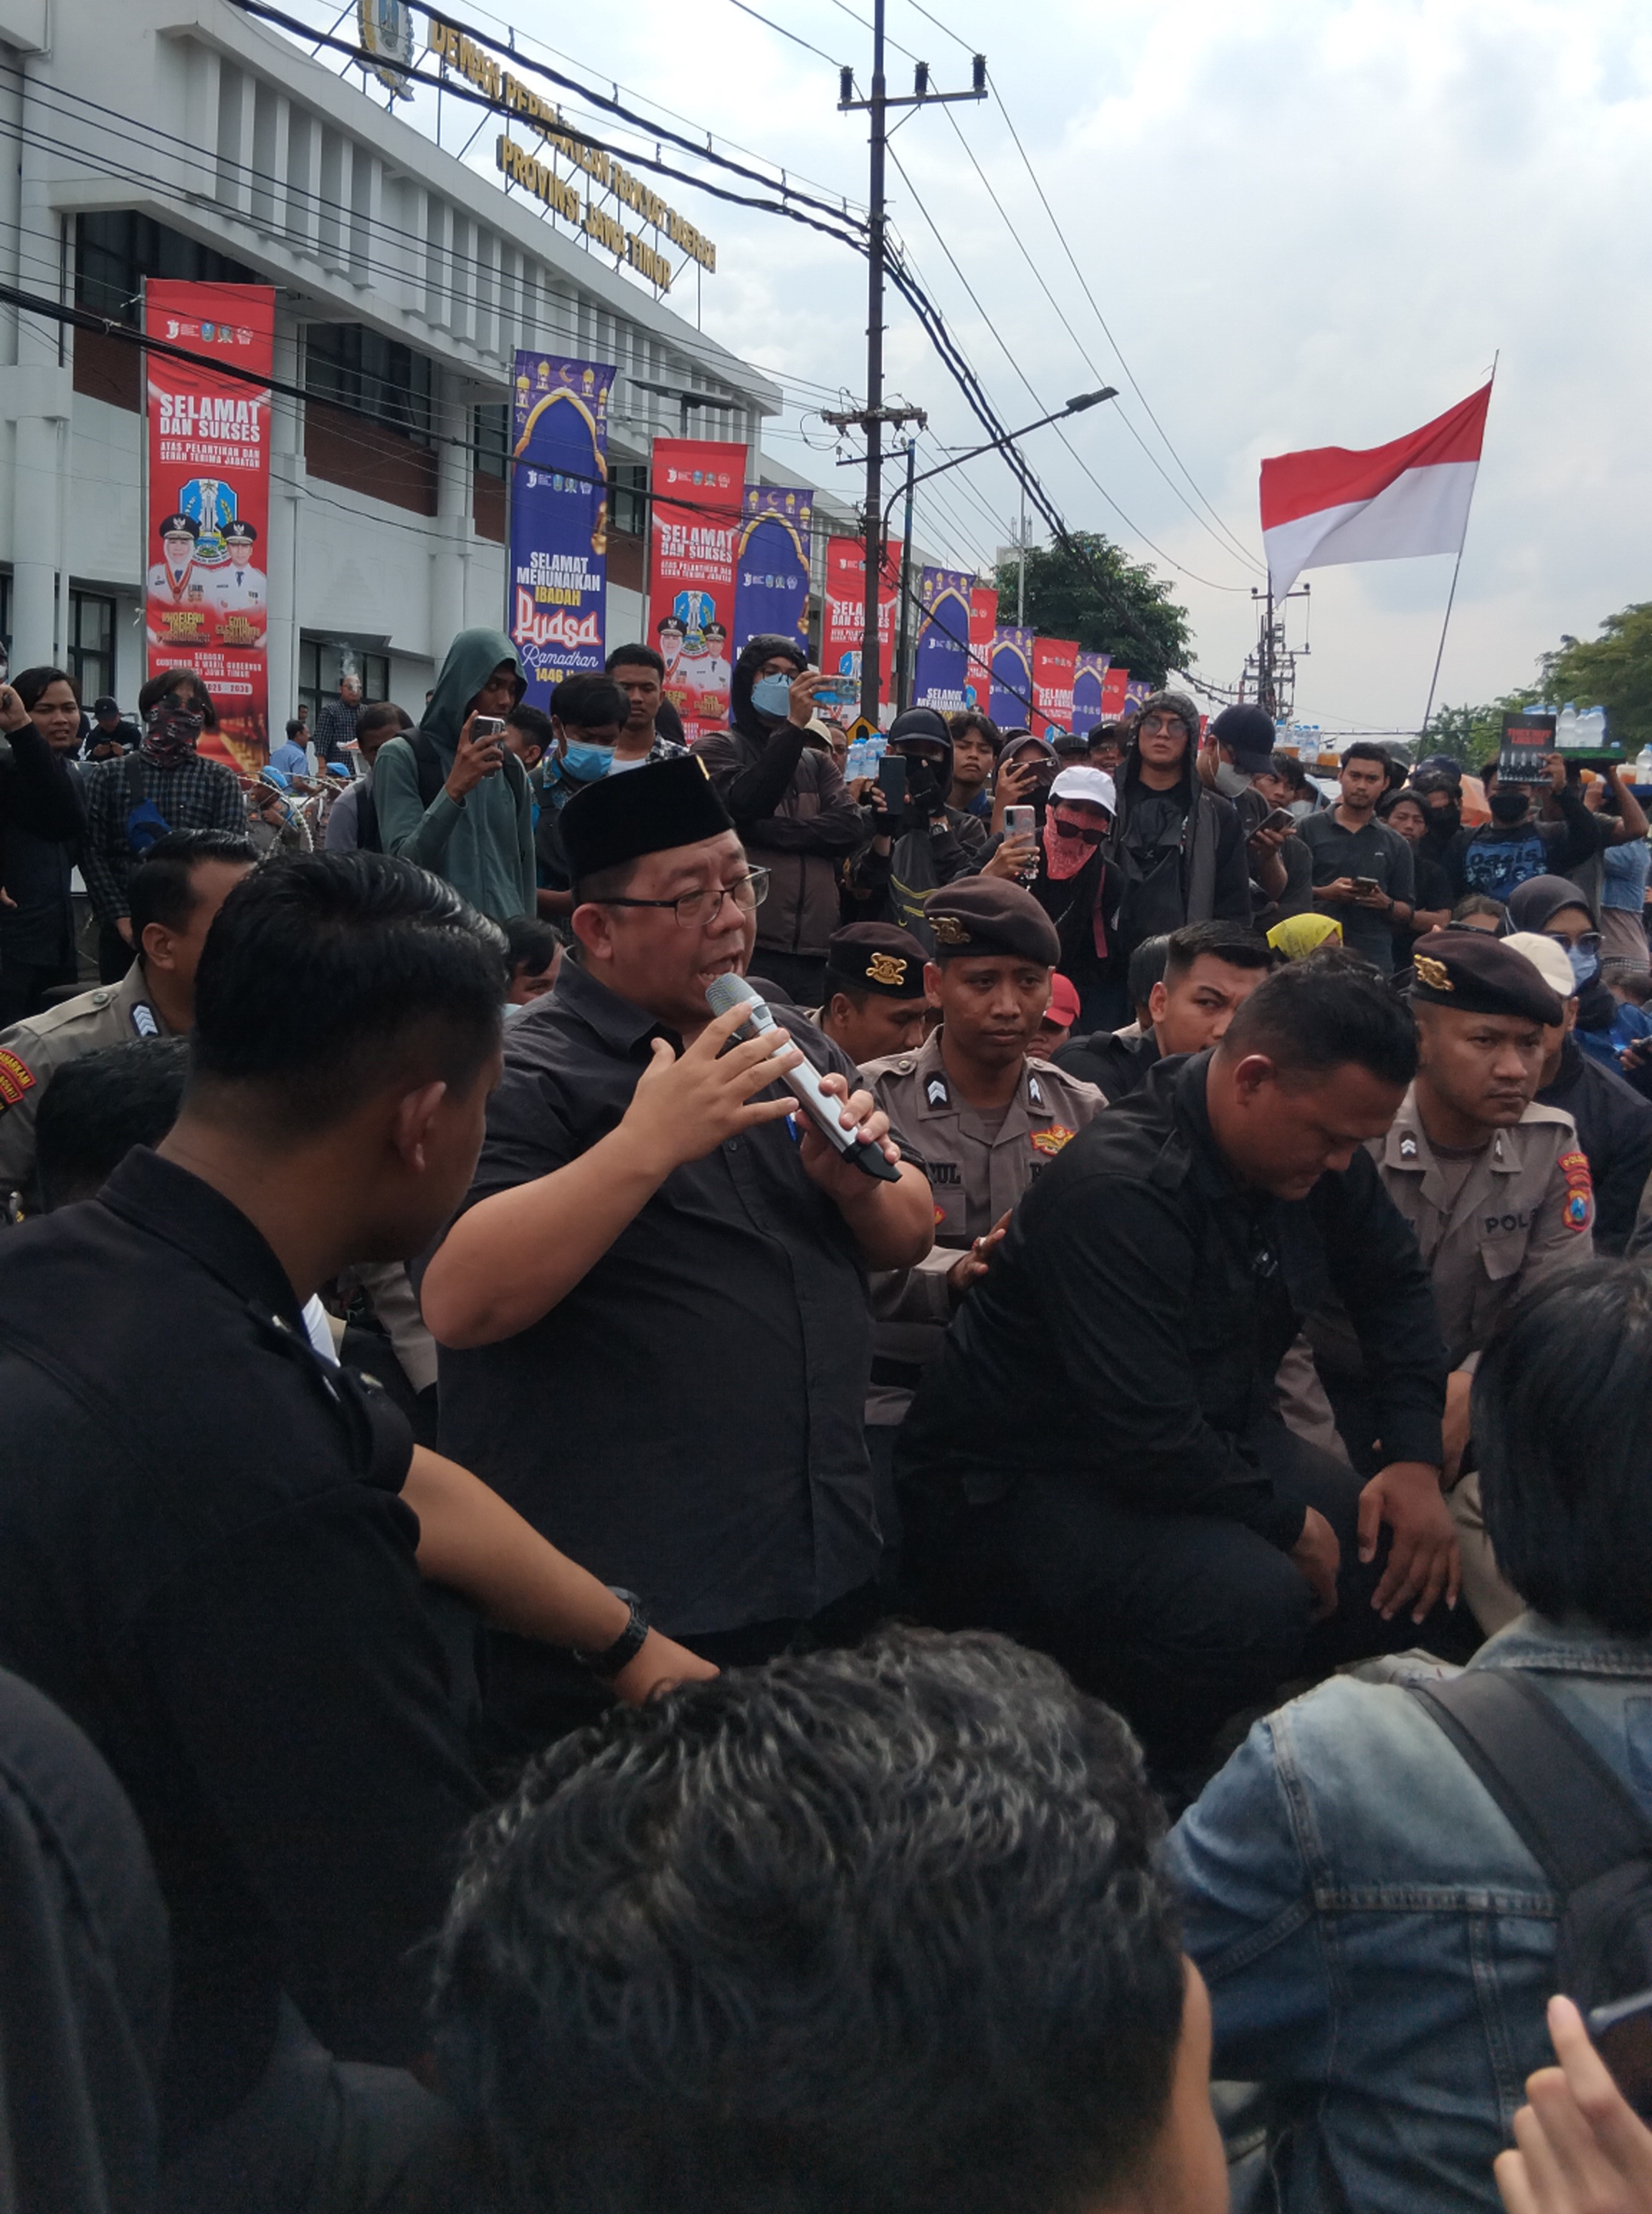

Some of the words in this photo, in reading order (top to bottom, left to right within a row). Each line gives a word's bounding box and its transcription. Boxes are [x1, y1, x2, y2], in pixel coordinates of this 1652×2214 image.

[429, 19, 500, 100] DEWAN
[497, 134, 580, 226] PROVINSI
[582, 201, 626, 257] JAWA
[625, 232, 671, 294] TIMUR
[160, 394, 260, 424] SELAMAT
[160, 417, 192, 436] DAN
[199, 420, 260, 442] SUKSES
[160, 442, 182, 451] ATAS
[186, 443, 239, 457] PELANTIKAN
[662, 524, 734, 551] SELAMAT
[530, 551, 589, 574] SELAMAT
[661, 542, 684, 557] DAN
[689, 546, 732, 563] SUKSES
[516, 566, 600, 591] MENUNAIKAN
[534, 586, 581, 607] IBADAH
[513, 586, 601, 648] Puasa
[832, 601, 889, 619] SELAAT
[854, 616, 889, 629] SUES
[521, 643, 599, 667] Ramadhan
[535, 667, 563, 683] 1446
[206, 683, 222, 692] 025
